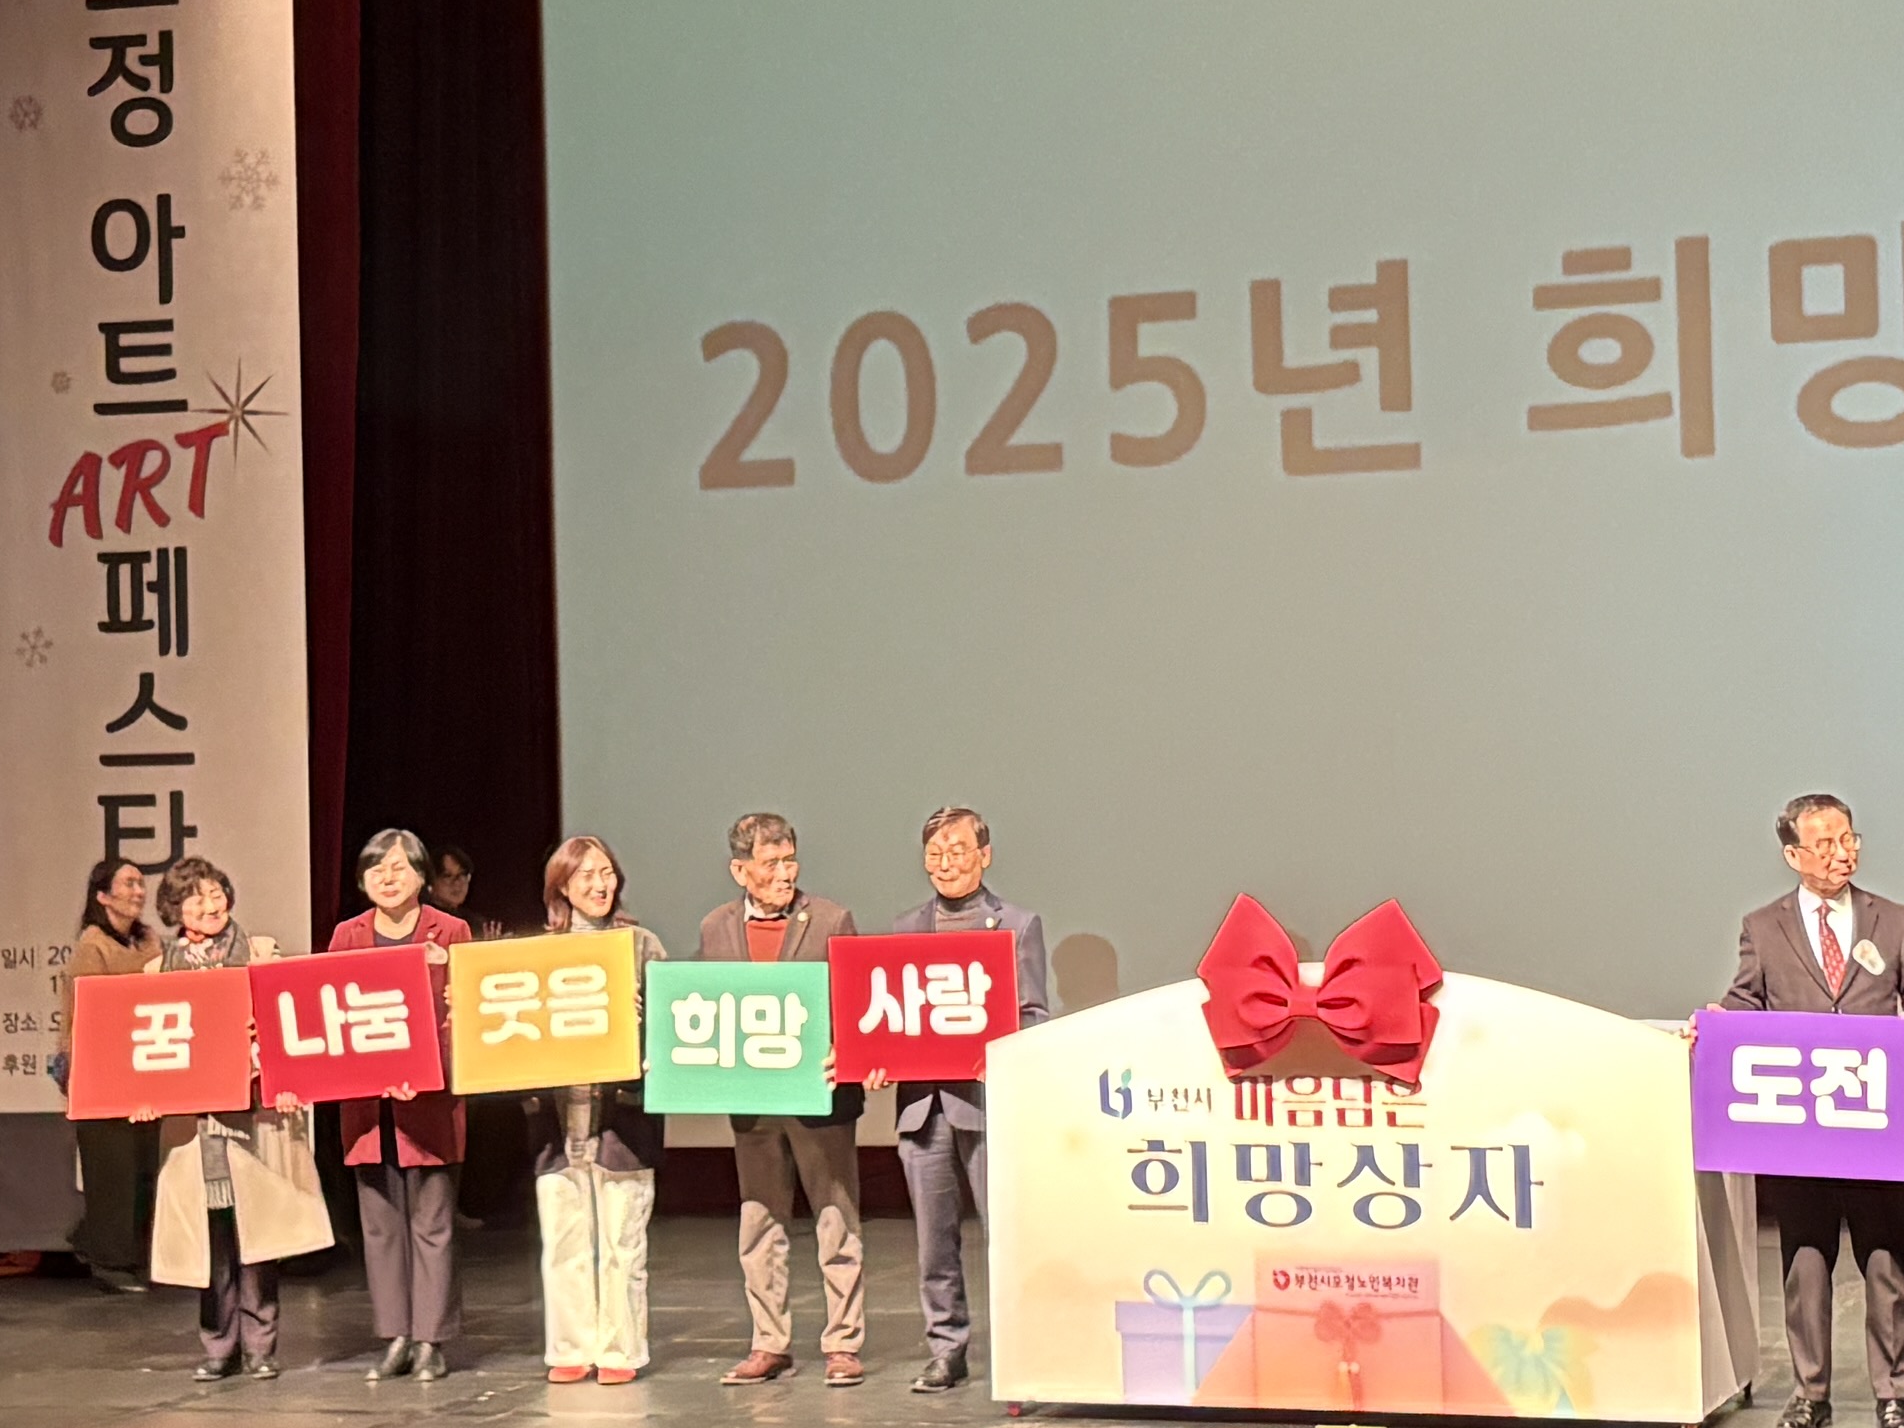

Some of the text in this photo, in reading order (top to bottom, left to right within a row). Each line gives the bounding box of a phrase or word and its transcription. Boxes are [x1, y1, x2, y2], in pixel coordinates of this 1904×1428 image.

[90, 192, 189, 416] 아트
[697, 257, 1423, 492] 2025년
[47, 420, 230, 549] ART
[96, 545, 199, 876] 페스타
[0, 945, 35, 970] 일시
[2, 1012, 38, 1034] 장소
[130, 1001, 194, 1071] 꿈
[277, 981, 411, 1057] 나눔
[477, 962, 610, 1046] 웃음
[669, 991, 809, 1069] 희망
[857, 960, 993, 1037] 사랑
[2, 1053, 37, 1076] 후원
[1147, 1087, 1212, 1113] 부천시
[1727, 1044, 1890, 1130] 도전
[1126, 1137, 1544, 1230] 희망상자
